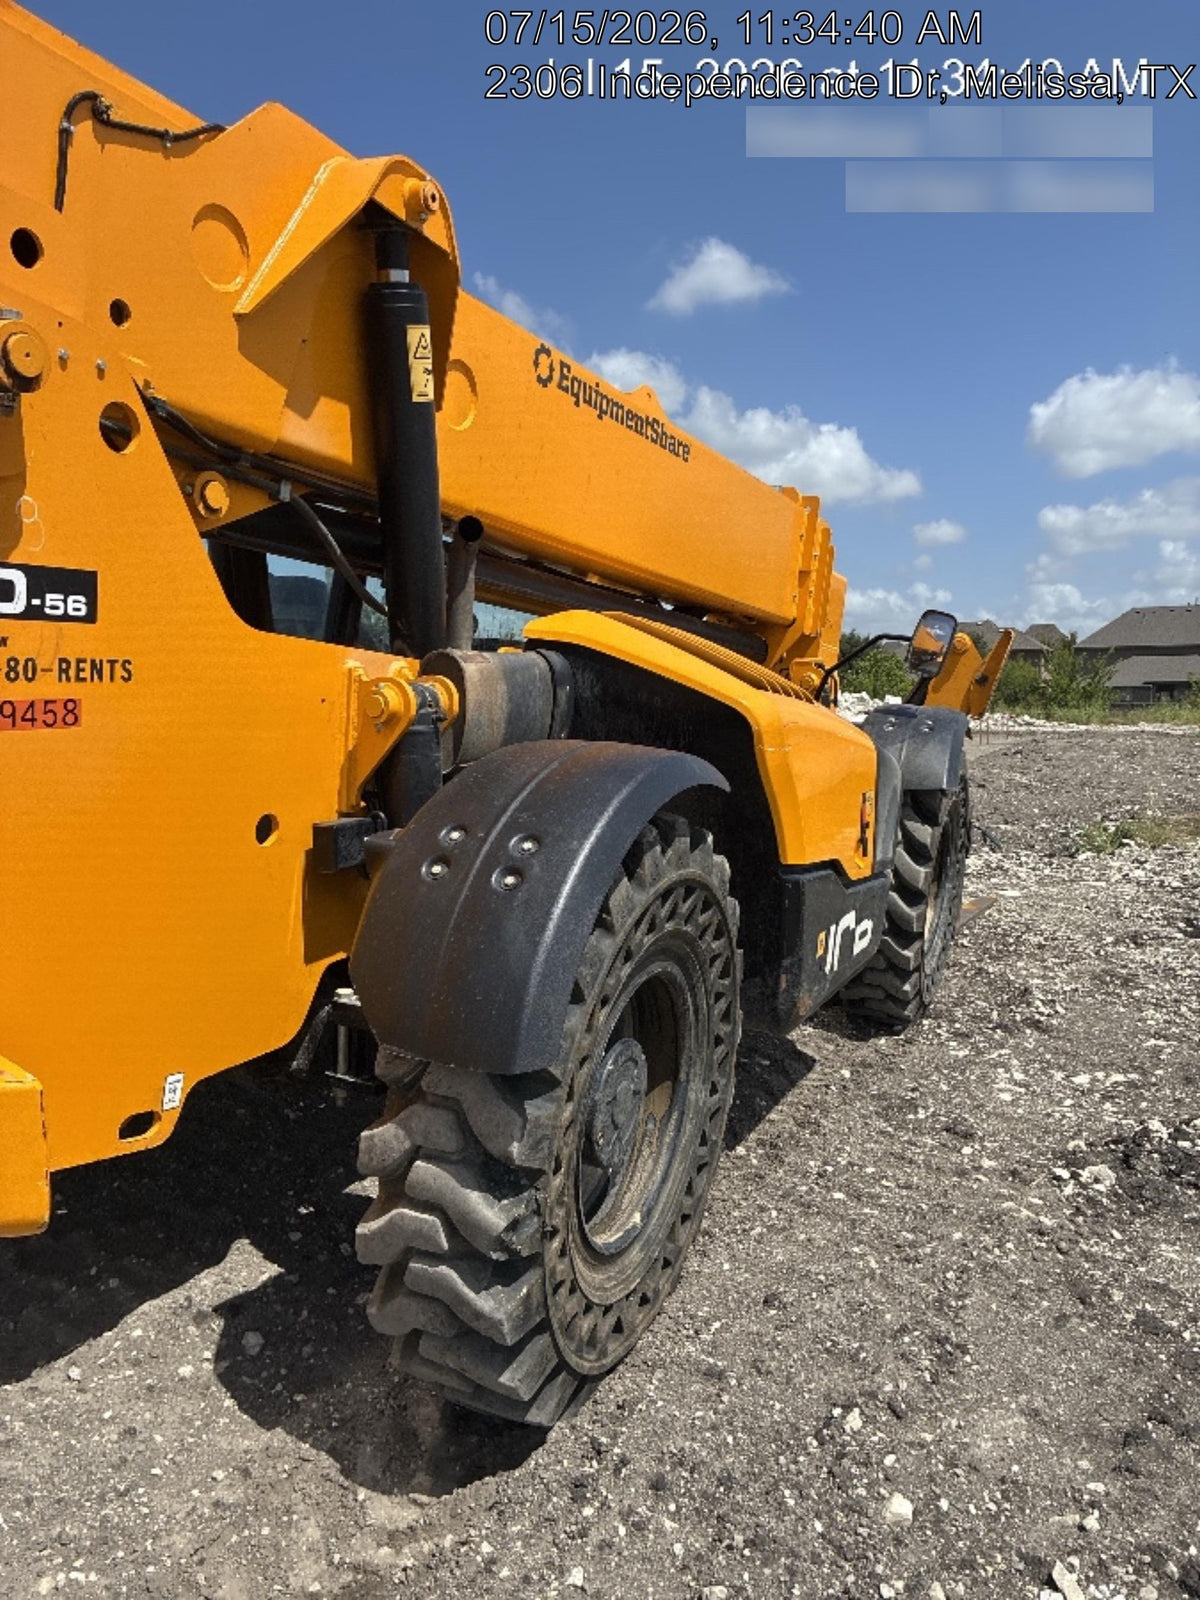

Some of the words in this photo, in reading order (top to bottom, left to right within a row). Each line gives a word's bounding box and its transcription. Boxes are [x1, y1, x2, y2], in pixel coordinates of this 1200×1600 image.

[557, 359, 690, 463] EquipmentShare
[0, 656, 133, 683] 80-RENTS
[0, 699, 79, 728] 9458
